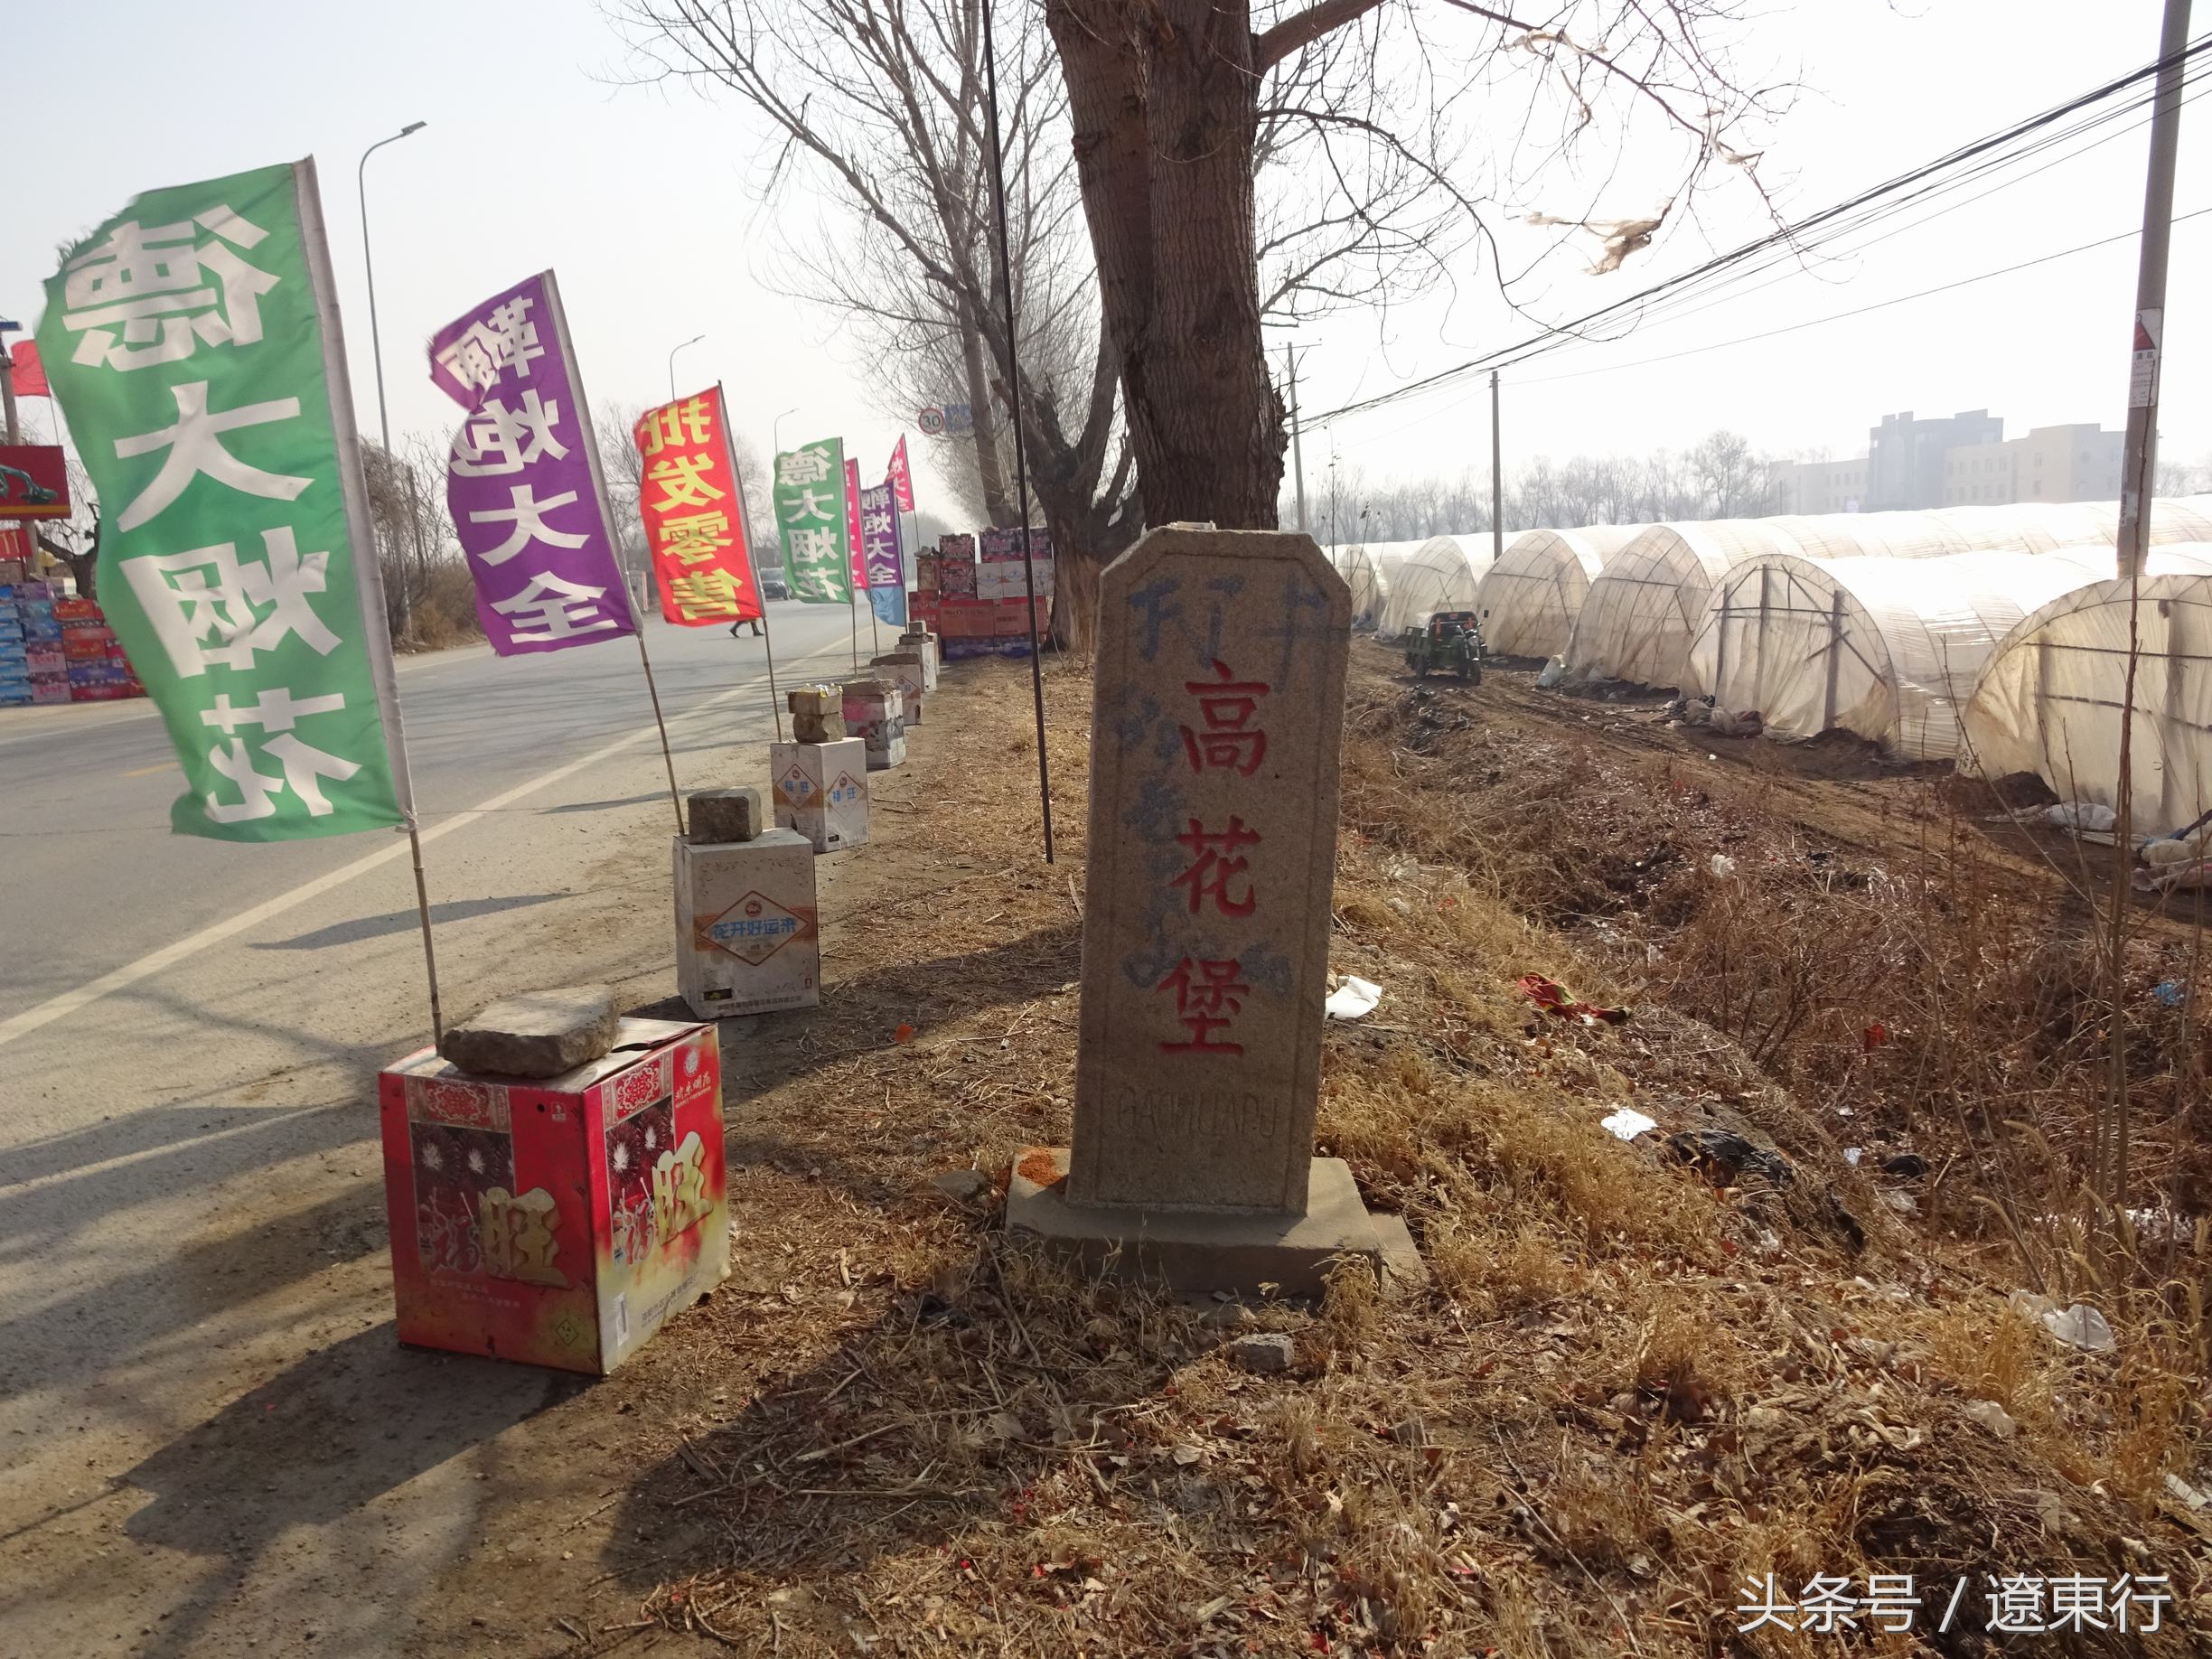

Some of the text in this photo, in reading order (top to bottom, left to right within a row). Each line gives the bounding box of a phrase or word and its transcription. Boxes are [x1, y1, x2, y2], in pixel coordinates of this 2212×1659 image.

[923, 416, 941, 427] 30
[1153, 659, 1271, 1057] 高花堡
[713, 916, 797, 940] 花开好运来
